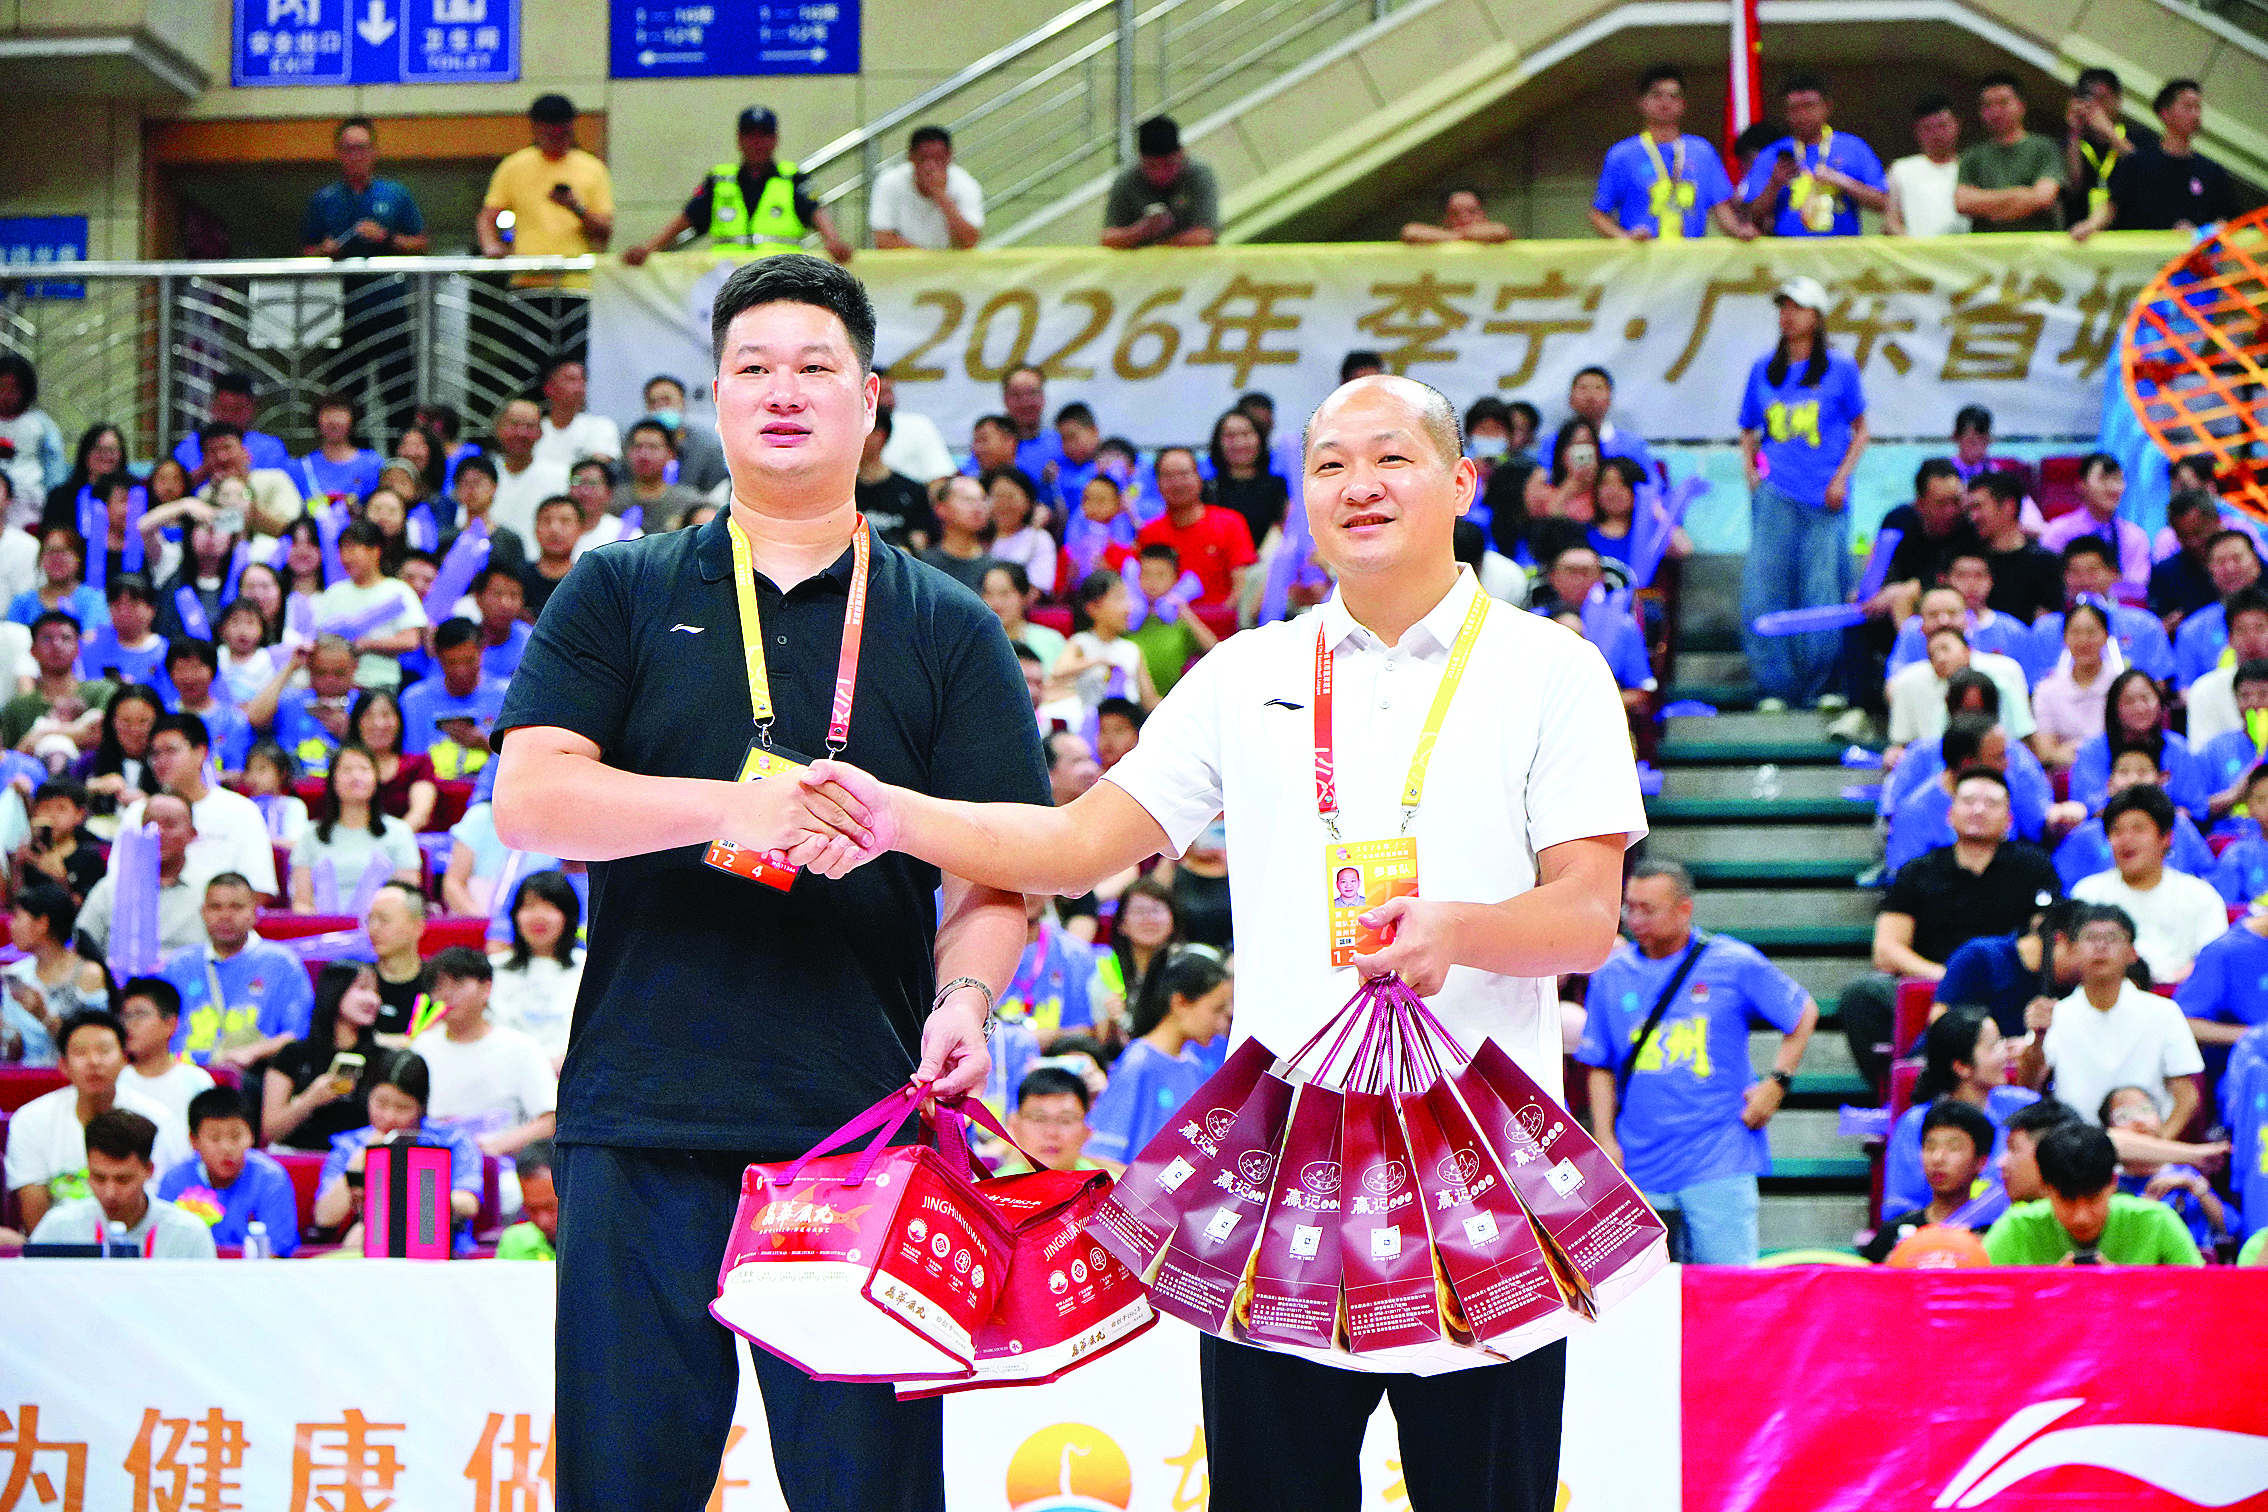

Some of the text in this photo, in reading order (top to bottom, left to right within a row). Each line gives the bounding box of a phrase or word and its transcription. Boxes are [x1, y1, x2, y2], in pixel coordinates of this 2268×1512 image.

[891, 275, 1315, 391] 2026年
[711, 849, 763, 878] 1 2 4
[1374, 864, 1410, 878] 参赛队
[1333, 950, 1341, 963] 1
[921, 1195, 988, 1257] JINGHUAYUWAN
